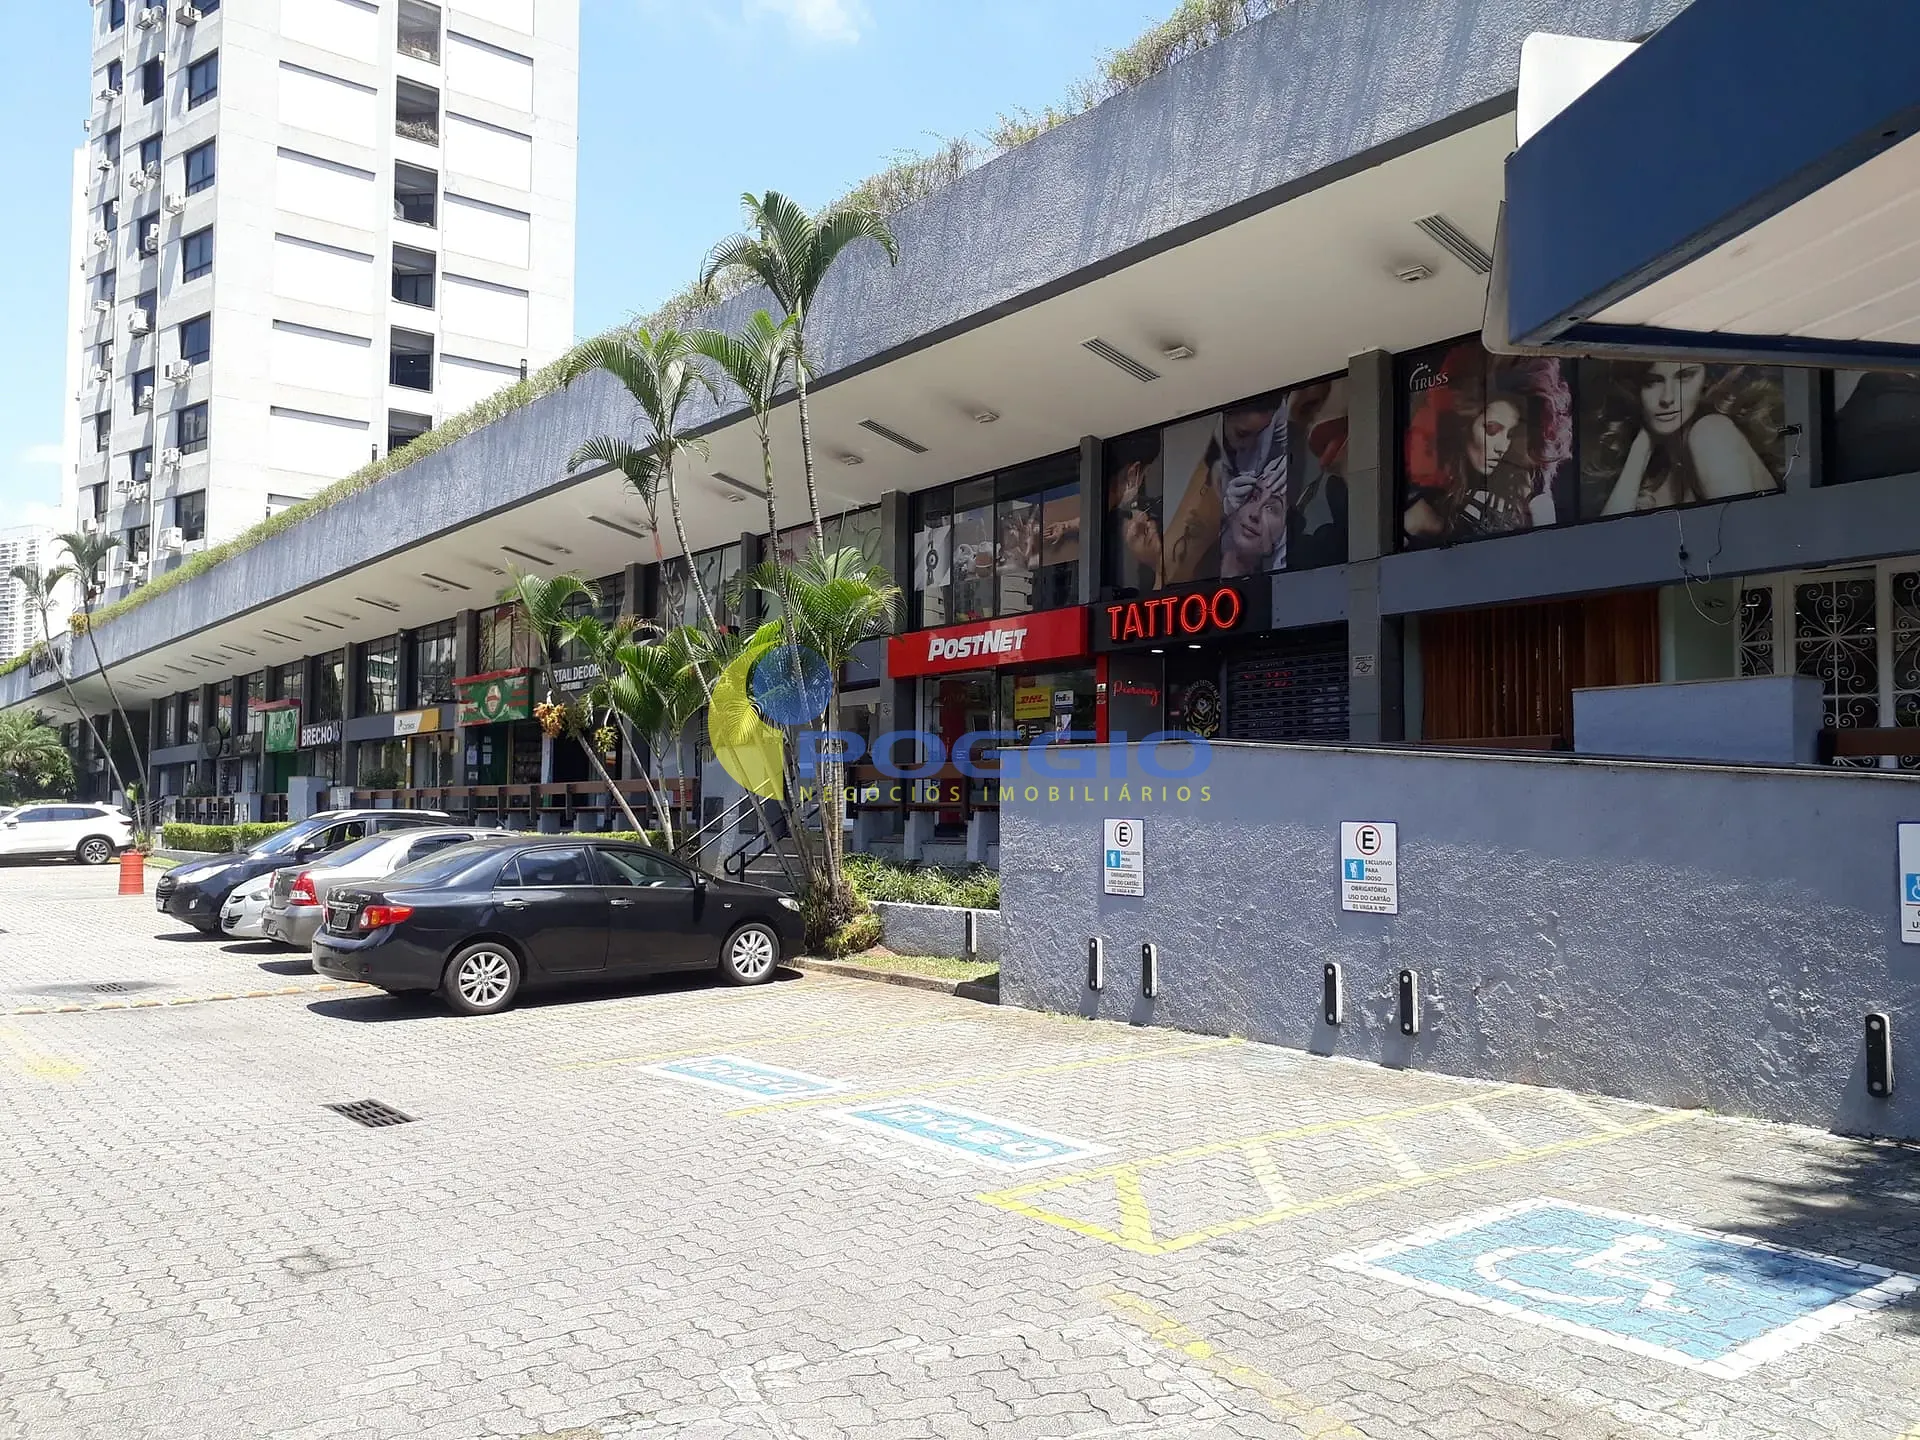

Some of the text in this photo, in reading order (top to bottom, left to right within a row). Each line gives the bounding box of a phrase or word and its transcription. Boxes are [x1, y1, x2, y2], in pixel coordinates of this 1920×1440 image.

[1415, 372, 1449, 391] TRUSS
[1107, 588, 1239, 641] TATTOO
[1119, 826, 1128, 843] E
[1362, 830, 1375, 850] E
